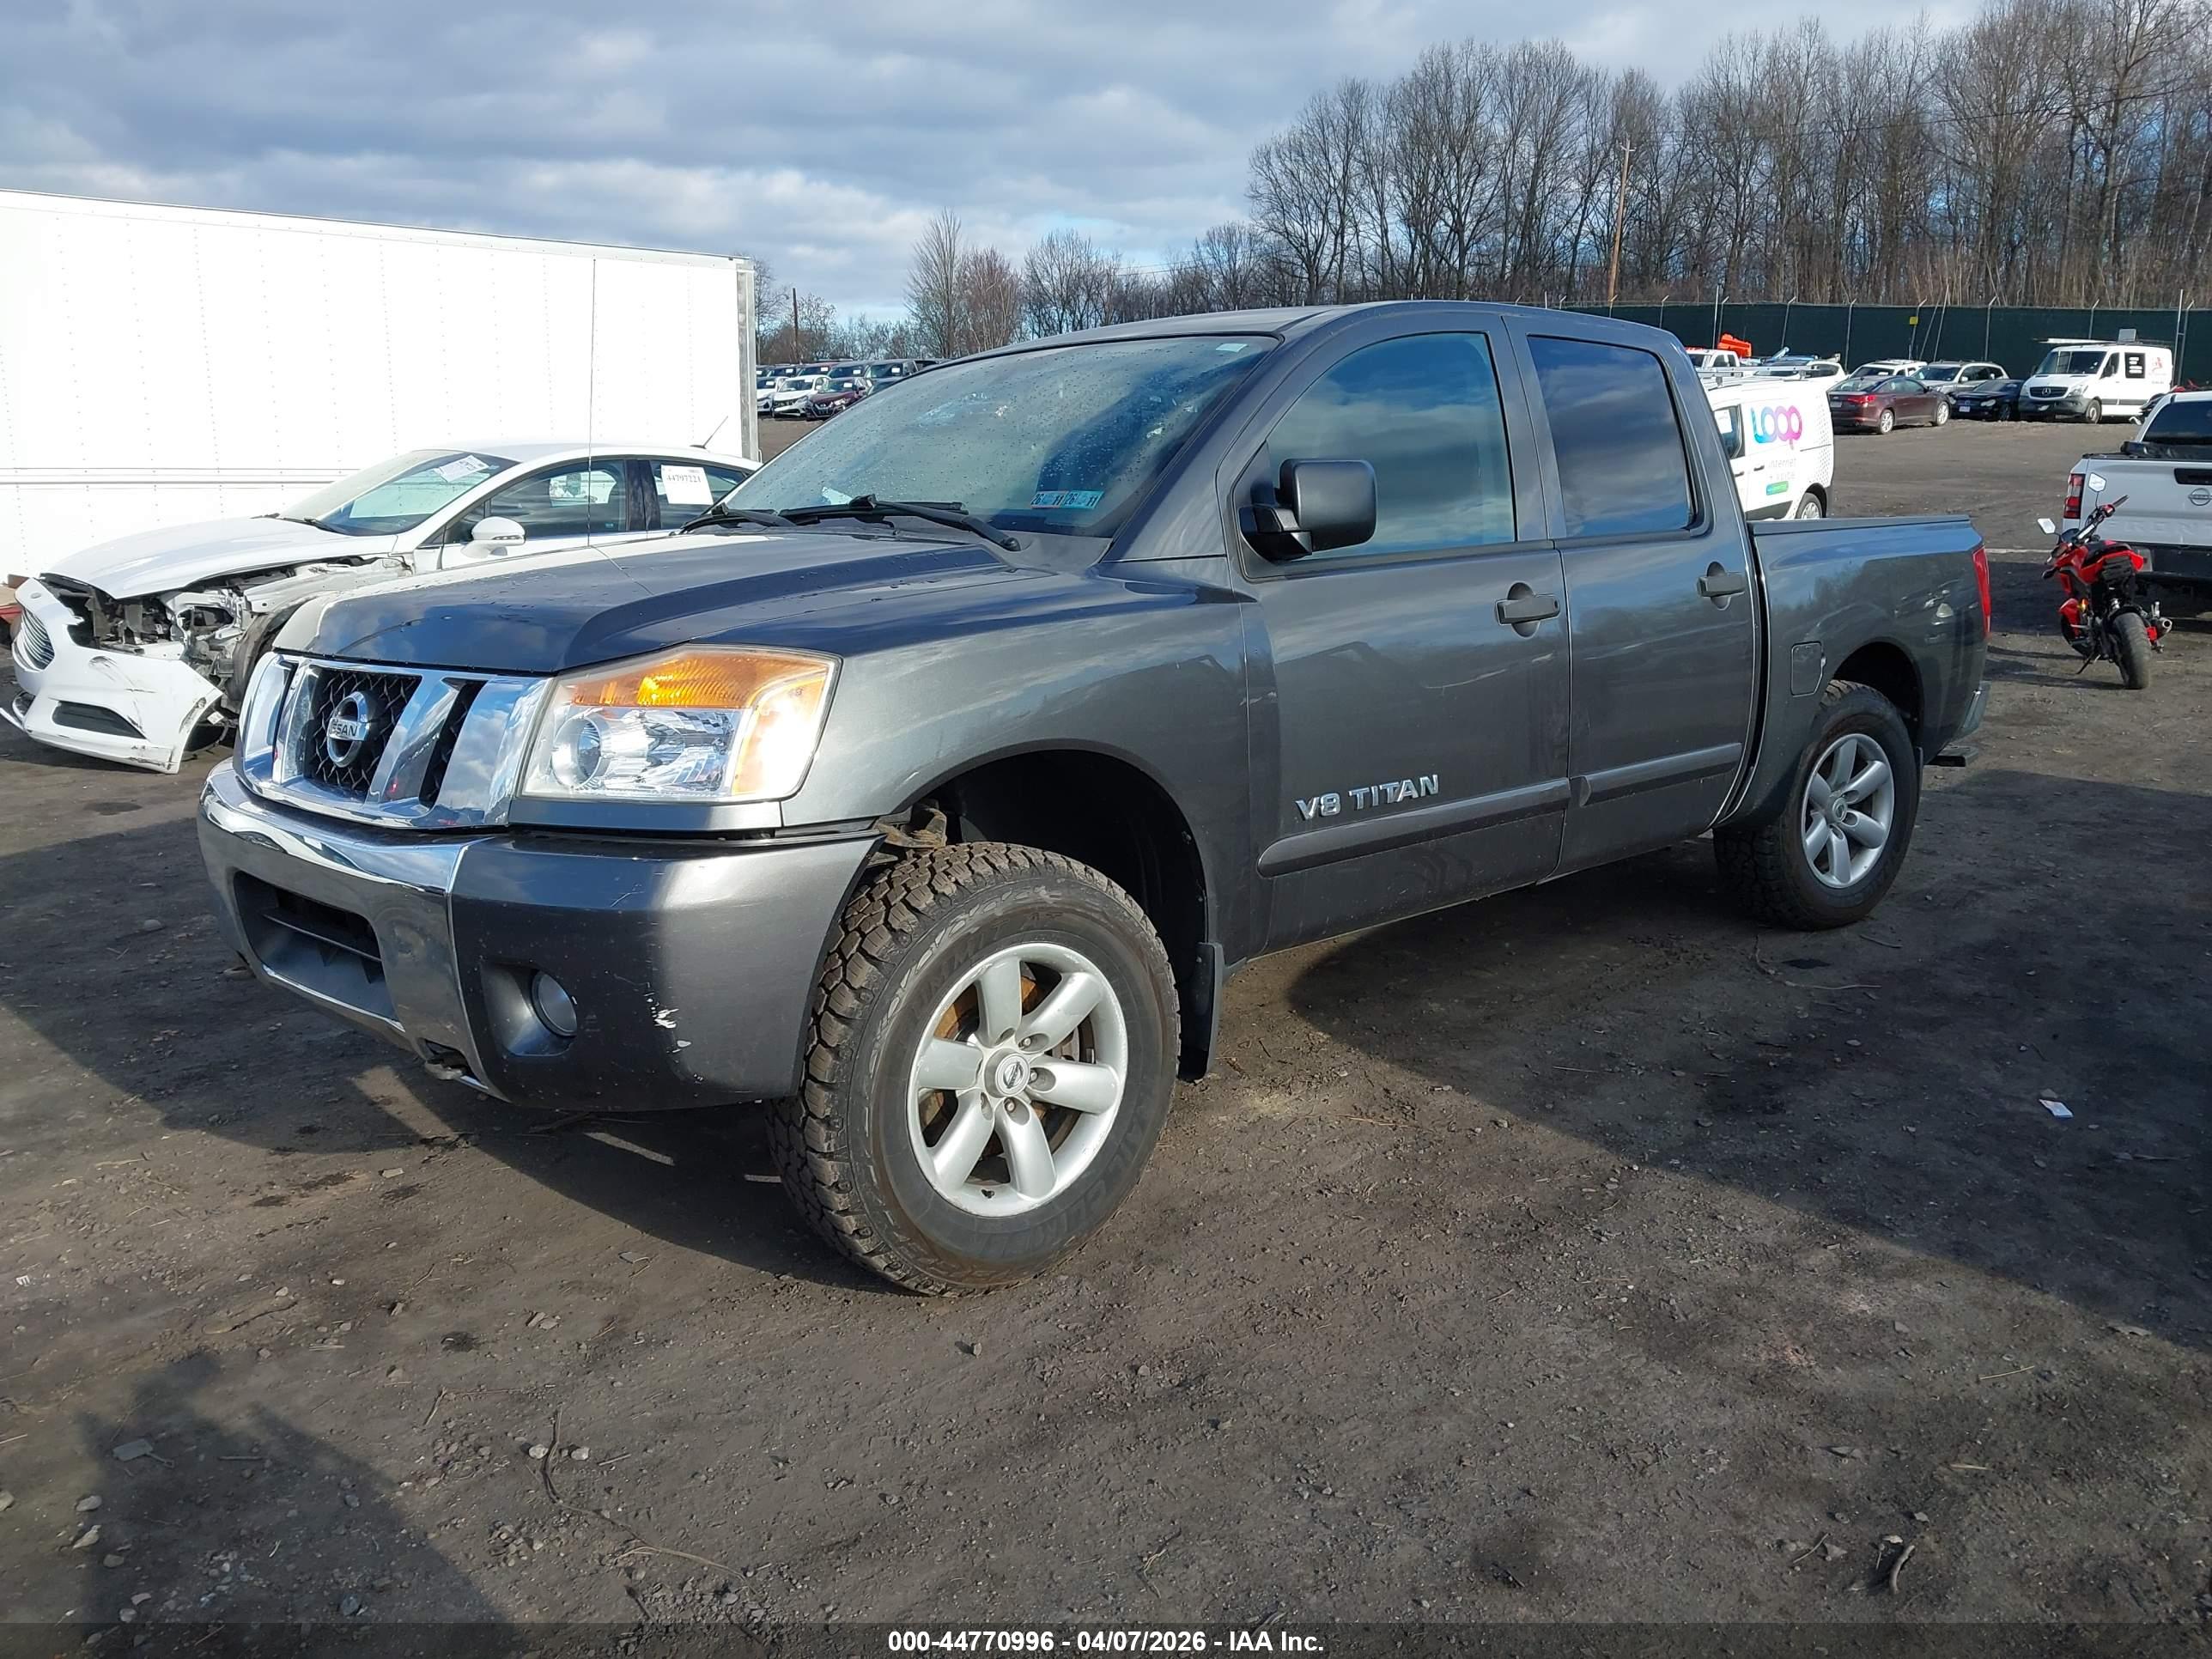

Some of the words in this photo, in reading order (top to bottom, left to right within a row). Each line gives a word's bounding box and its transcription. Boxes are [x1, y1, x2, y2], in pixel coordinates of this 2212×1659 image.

[1031, 493, 1045, 505] 26
[1052, 495, 1064, 506] 11
[1065, 493, 1079, 505] 26
[1085, 495, 1097, 507] 11
[1294, 792, 1341, 821] V8
[1348, 774, 1440, 811] TITAN
